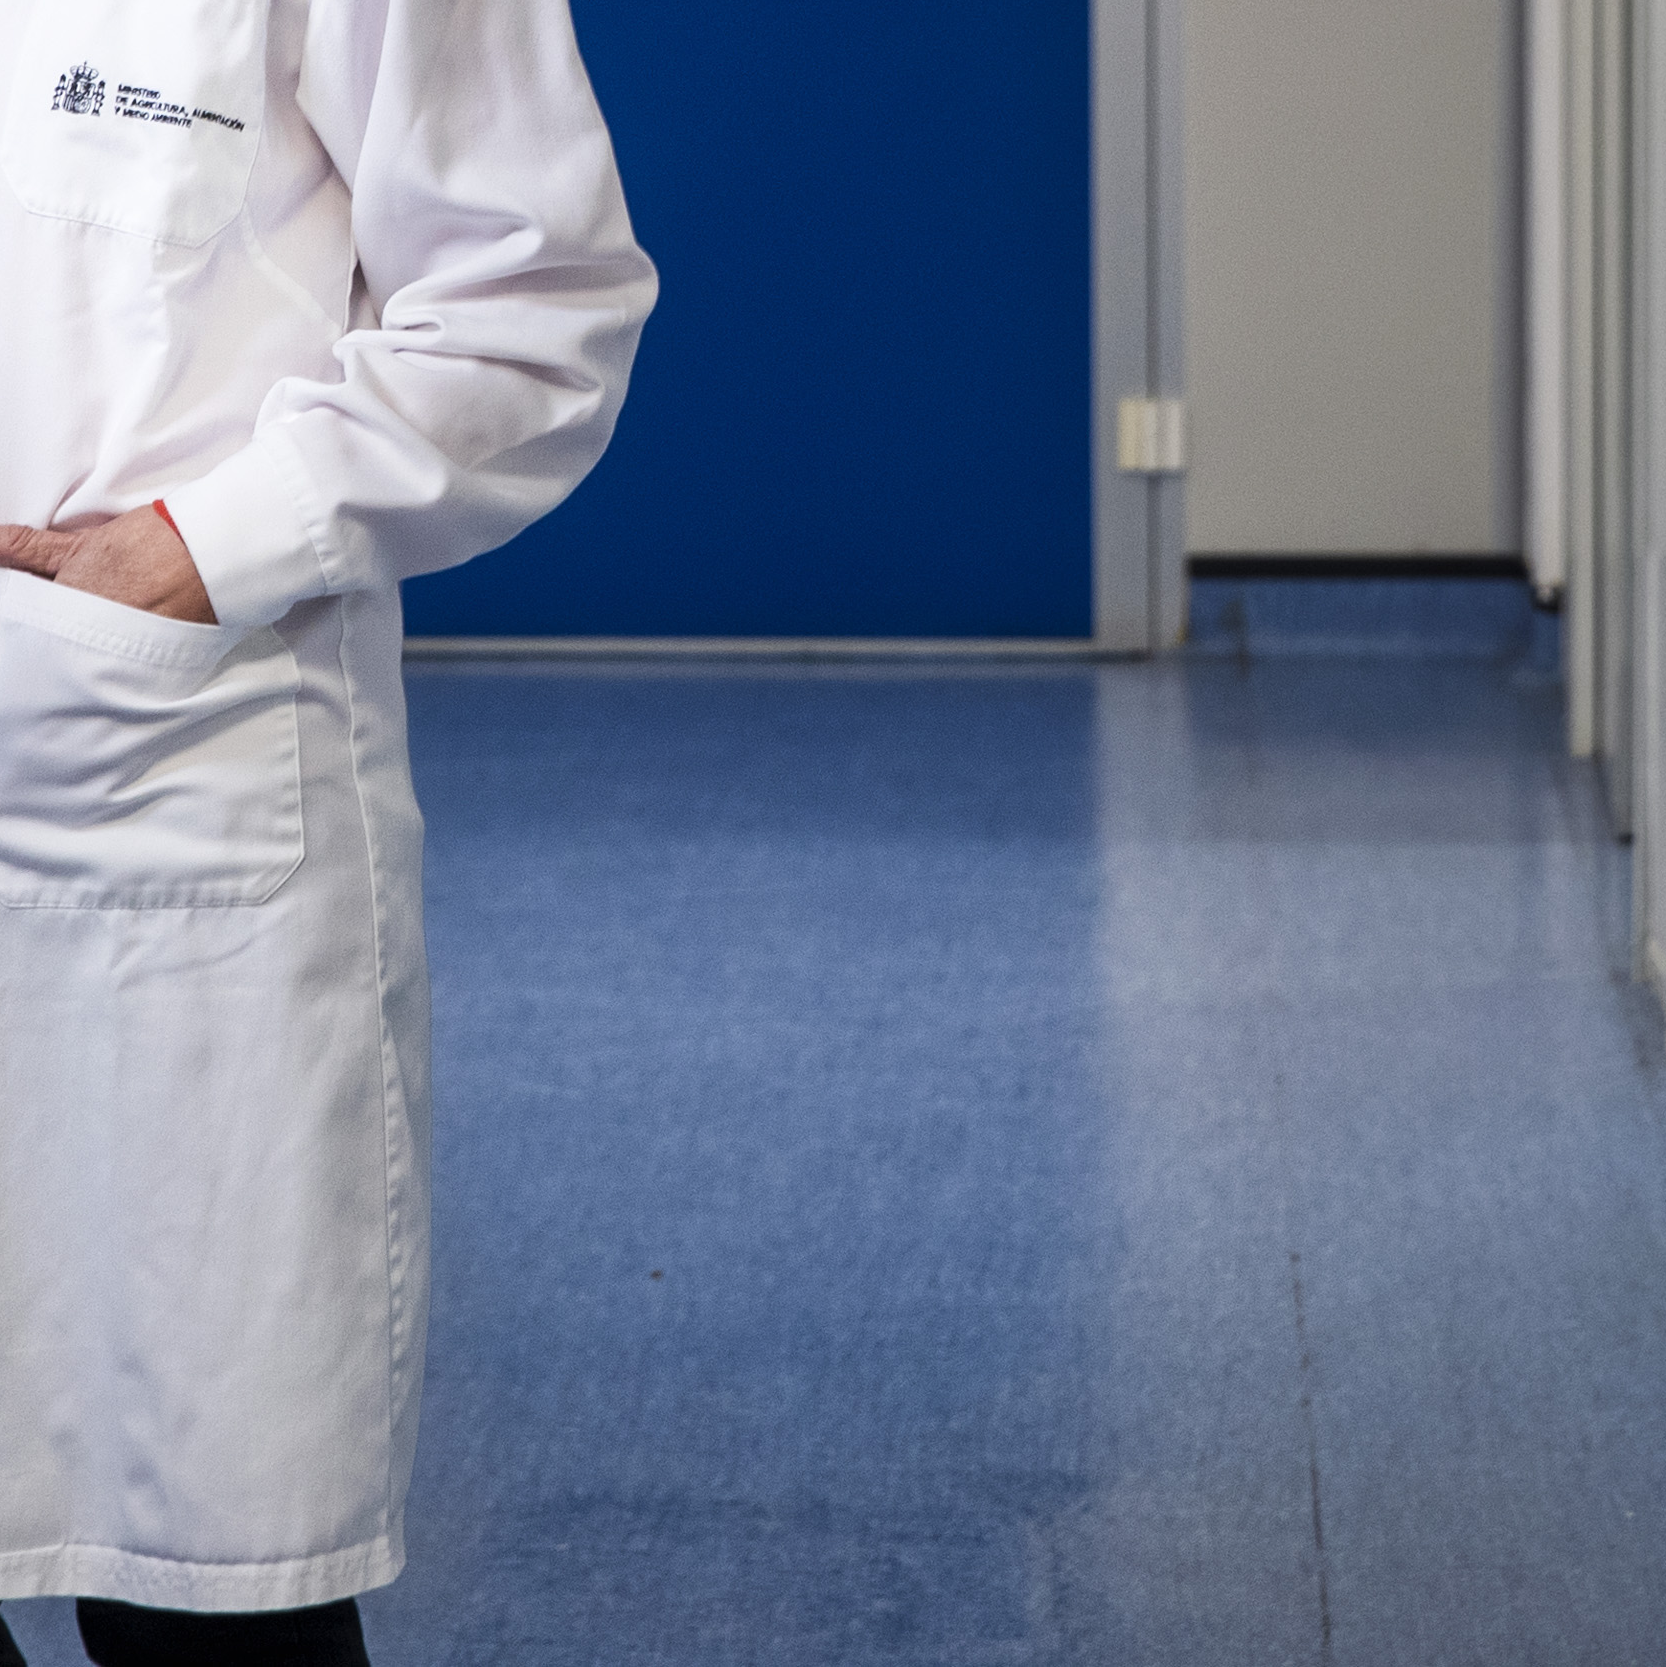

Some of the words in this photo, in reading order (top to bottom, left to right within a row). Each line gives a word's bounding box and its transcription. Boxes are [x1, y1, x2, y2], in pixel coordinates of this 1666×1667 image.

[115, 106, 121, 114] Y
[116, 96, 129, 106] DE
[131, 98, 189, 117] AGRICULTURA,
